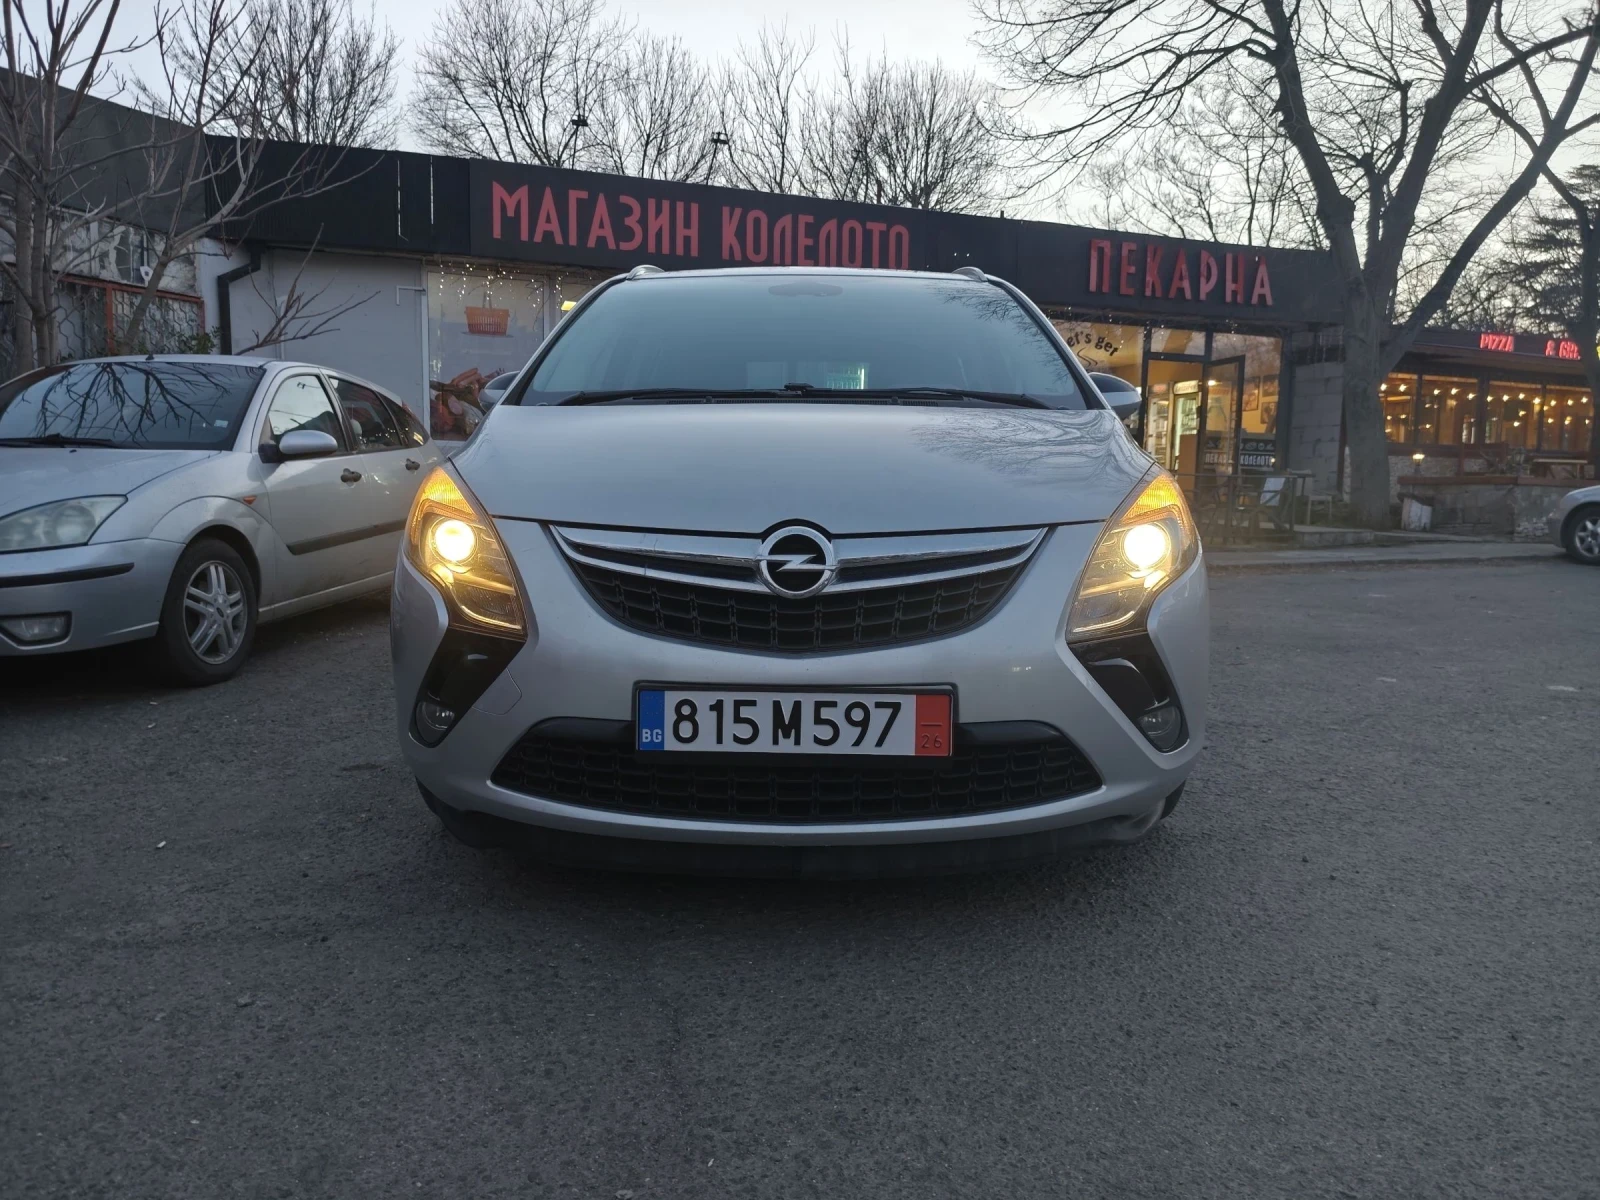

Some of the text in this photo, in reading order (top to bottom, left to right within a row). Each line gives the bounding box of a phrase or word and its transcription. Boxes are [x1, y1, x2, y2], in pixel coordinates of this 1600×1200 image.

[492, 181, 910, 270] МАГАЗИН КОЛЕЛОТО
[1089, 239, 1273, 306] ПЕКАРНА
[1094, 336, 1119, 356] get
[1480, 333, 1514, 352] PIZZA
[642, 729, 662, 742] BG
[921, 734, 943, 748] 26
